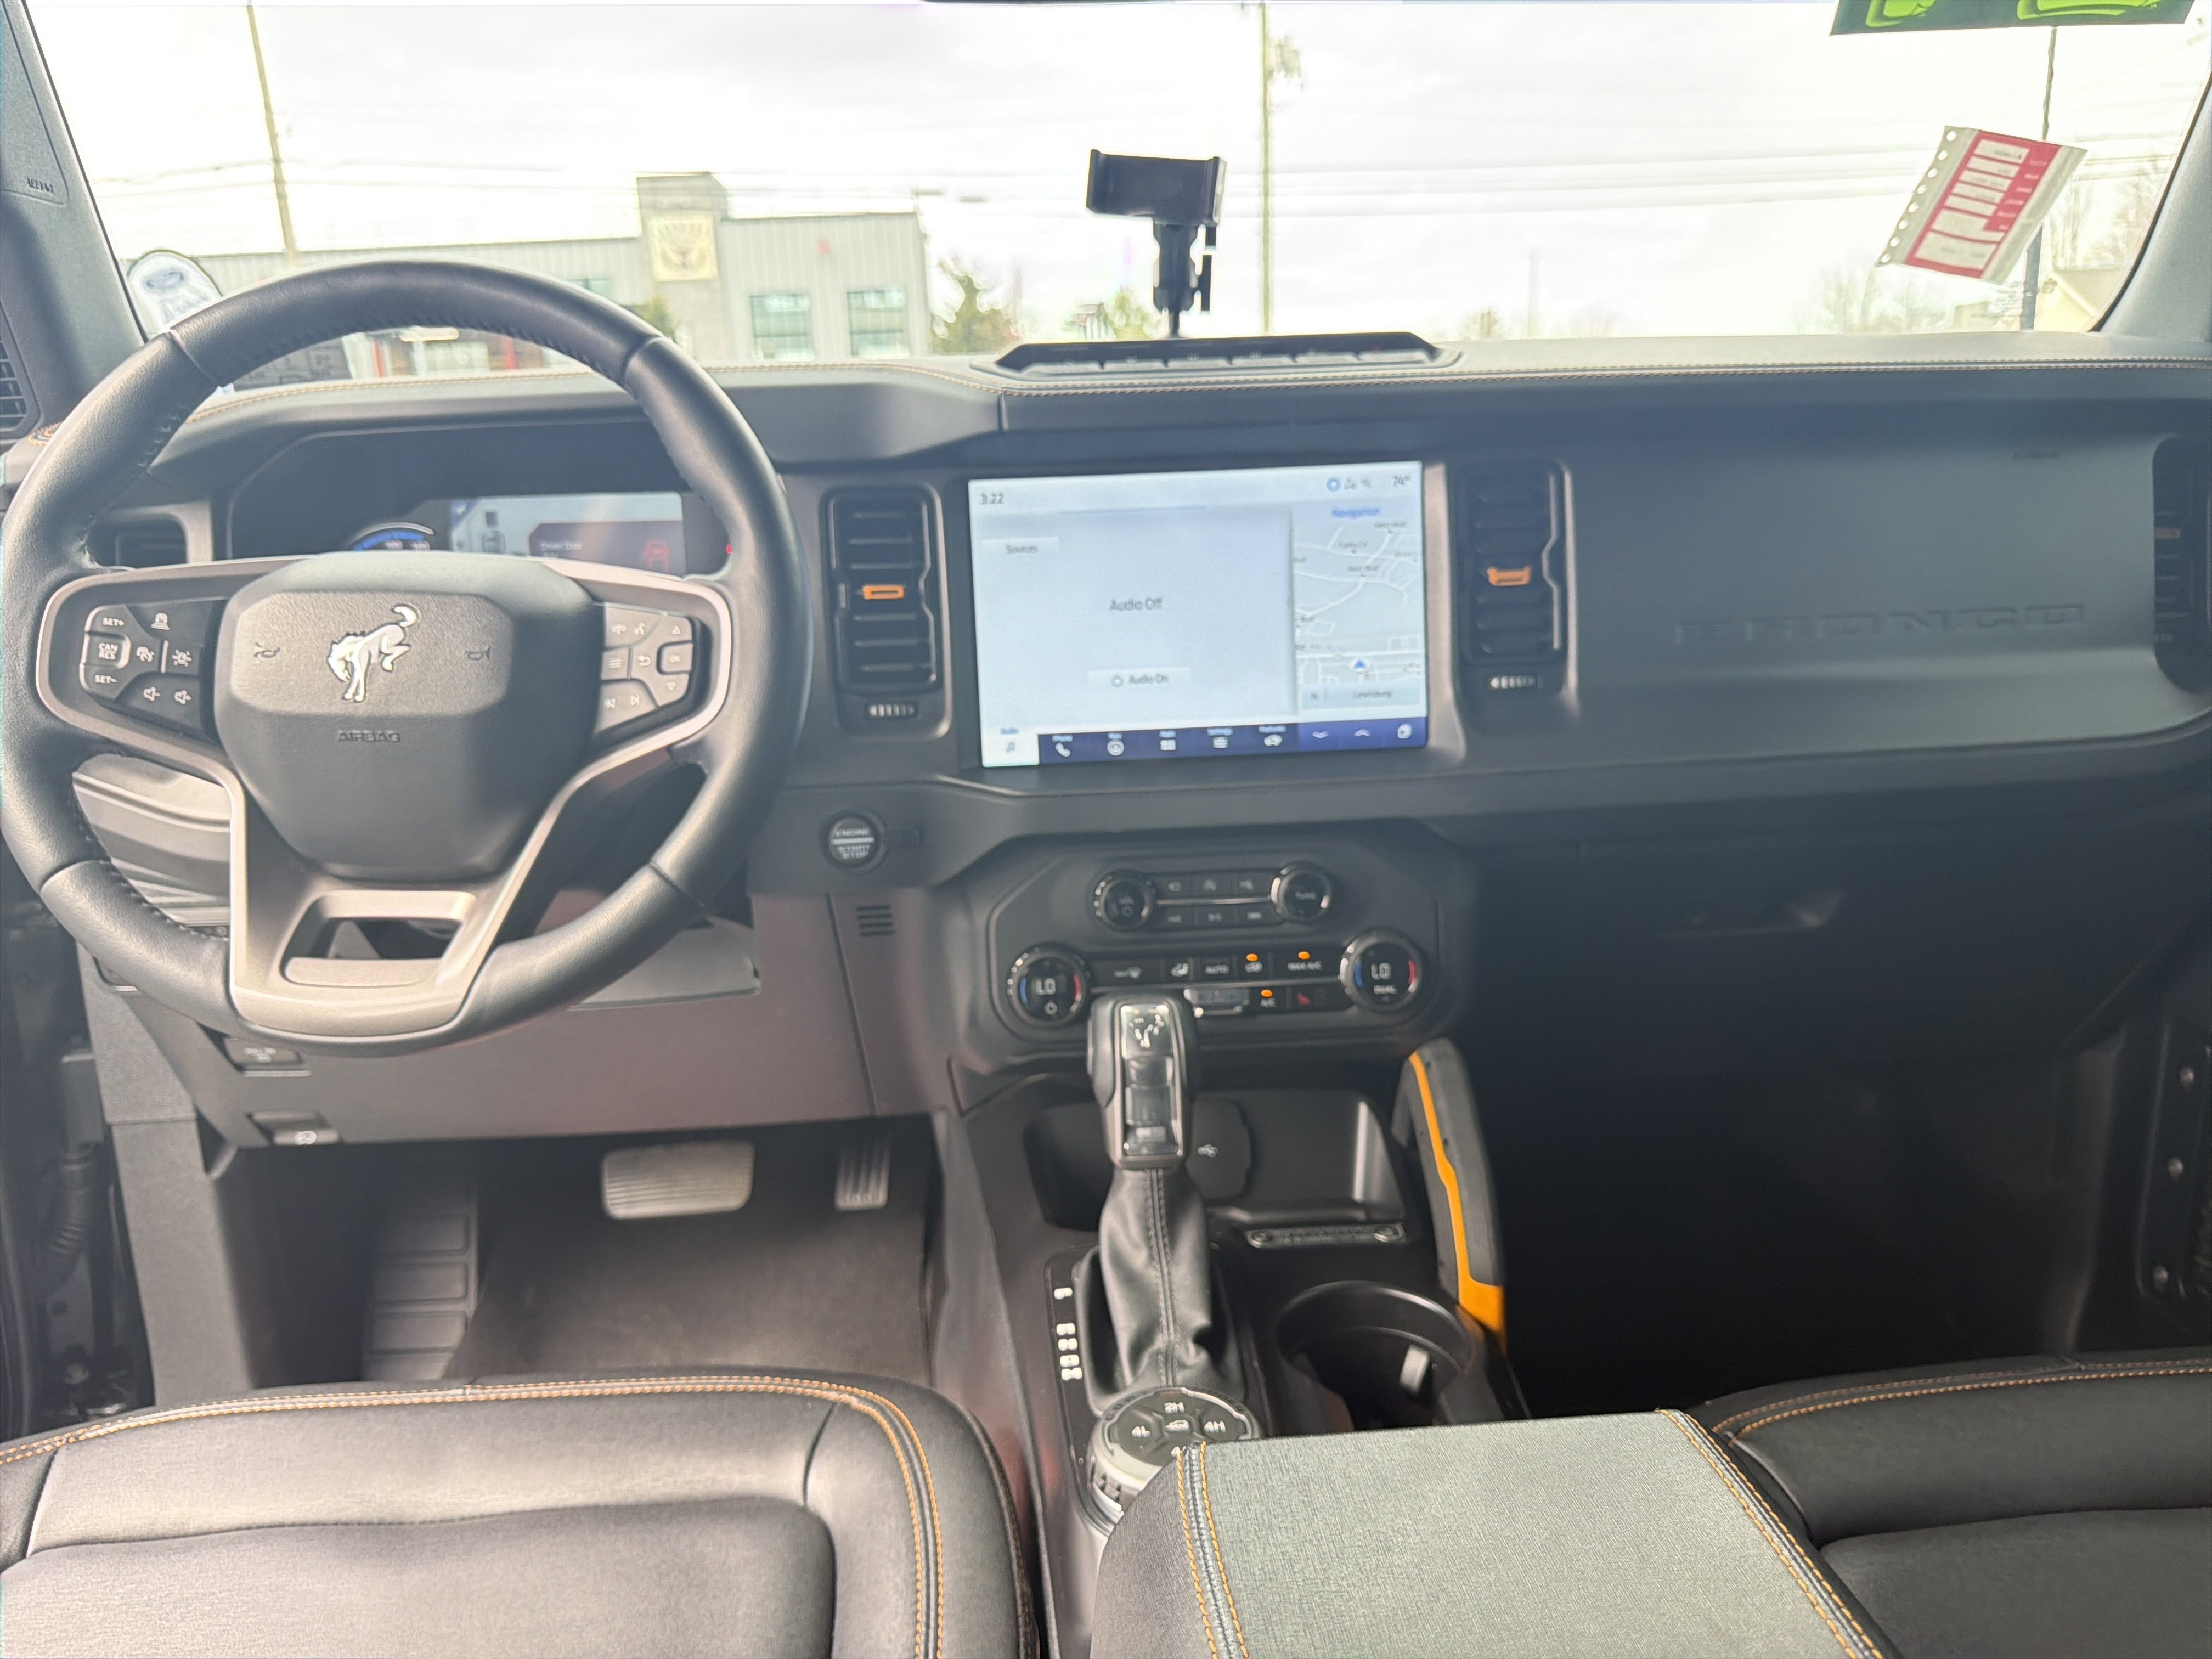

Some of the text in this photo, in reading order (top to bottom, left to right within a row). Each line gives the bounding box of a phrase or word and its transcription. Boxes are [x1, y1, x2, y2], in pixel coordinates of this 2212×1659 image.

[980, 492, 1005, 505] 3:22
[1110, 597, 1163, 611] Audio Off
[99, 642, 118, 652] CAN
[1128, 675, 1154, 684] Audio
[337, 729, 402, 742] AIRBAG
[1371, 962, 1392, 980] LO
[1036, 977, 1056, 996] LO
[1164, 1402, 1184, 1414] 2H
[1131, 1426, 1151, 1437] 4L
[1204, 1421, 1226, 1433] 4H
